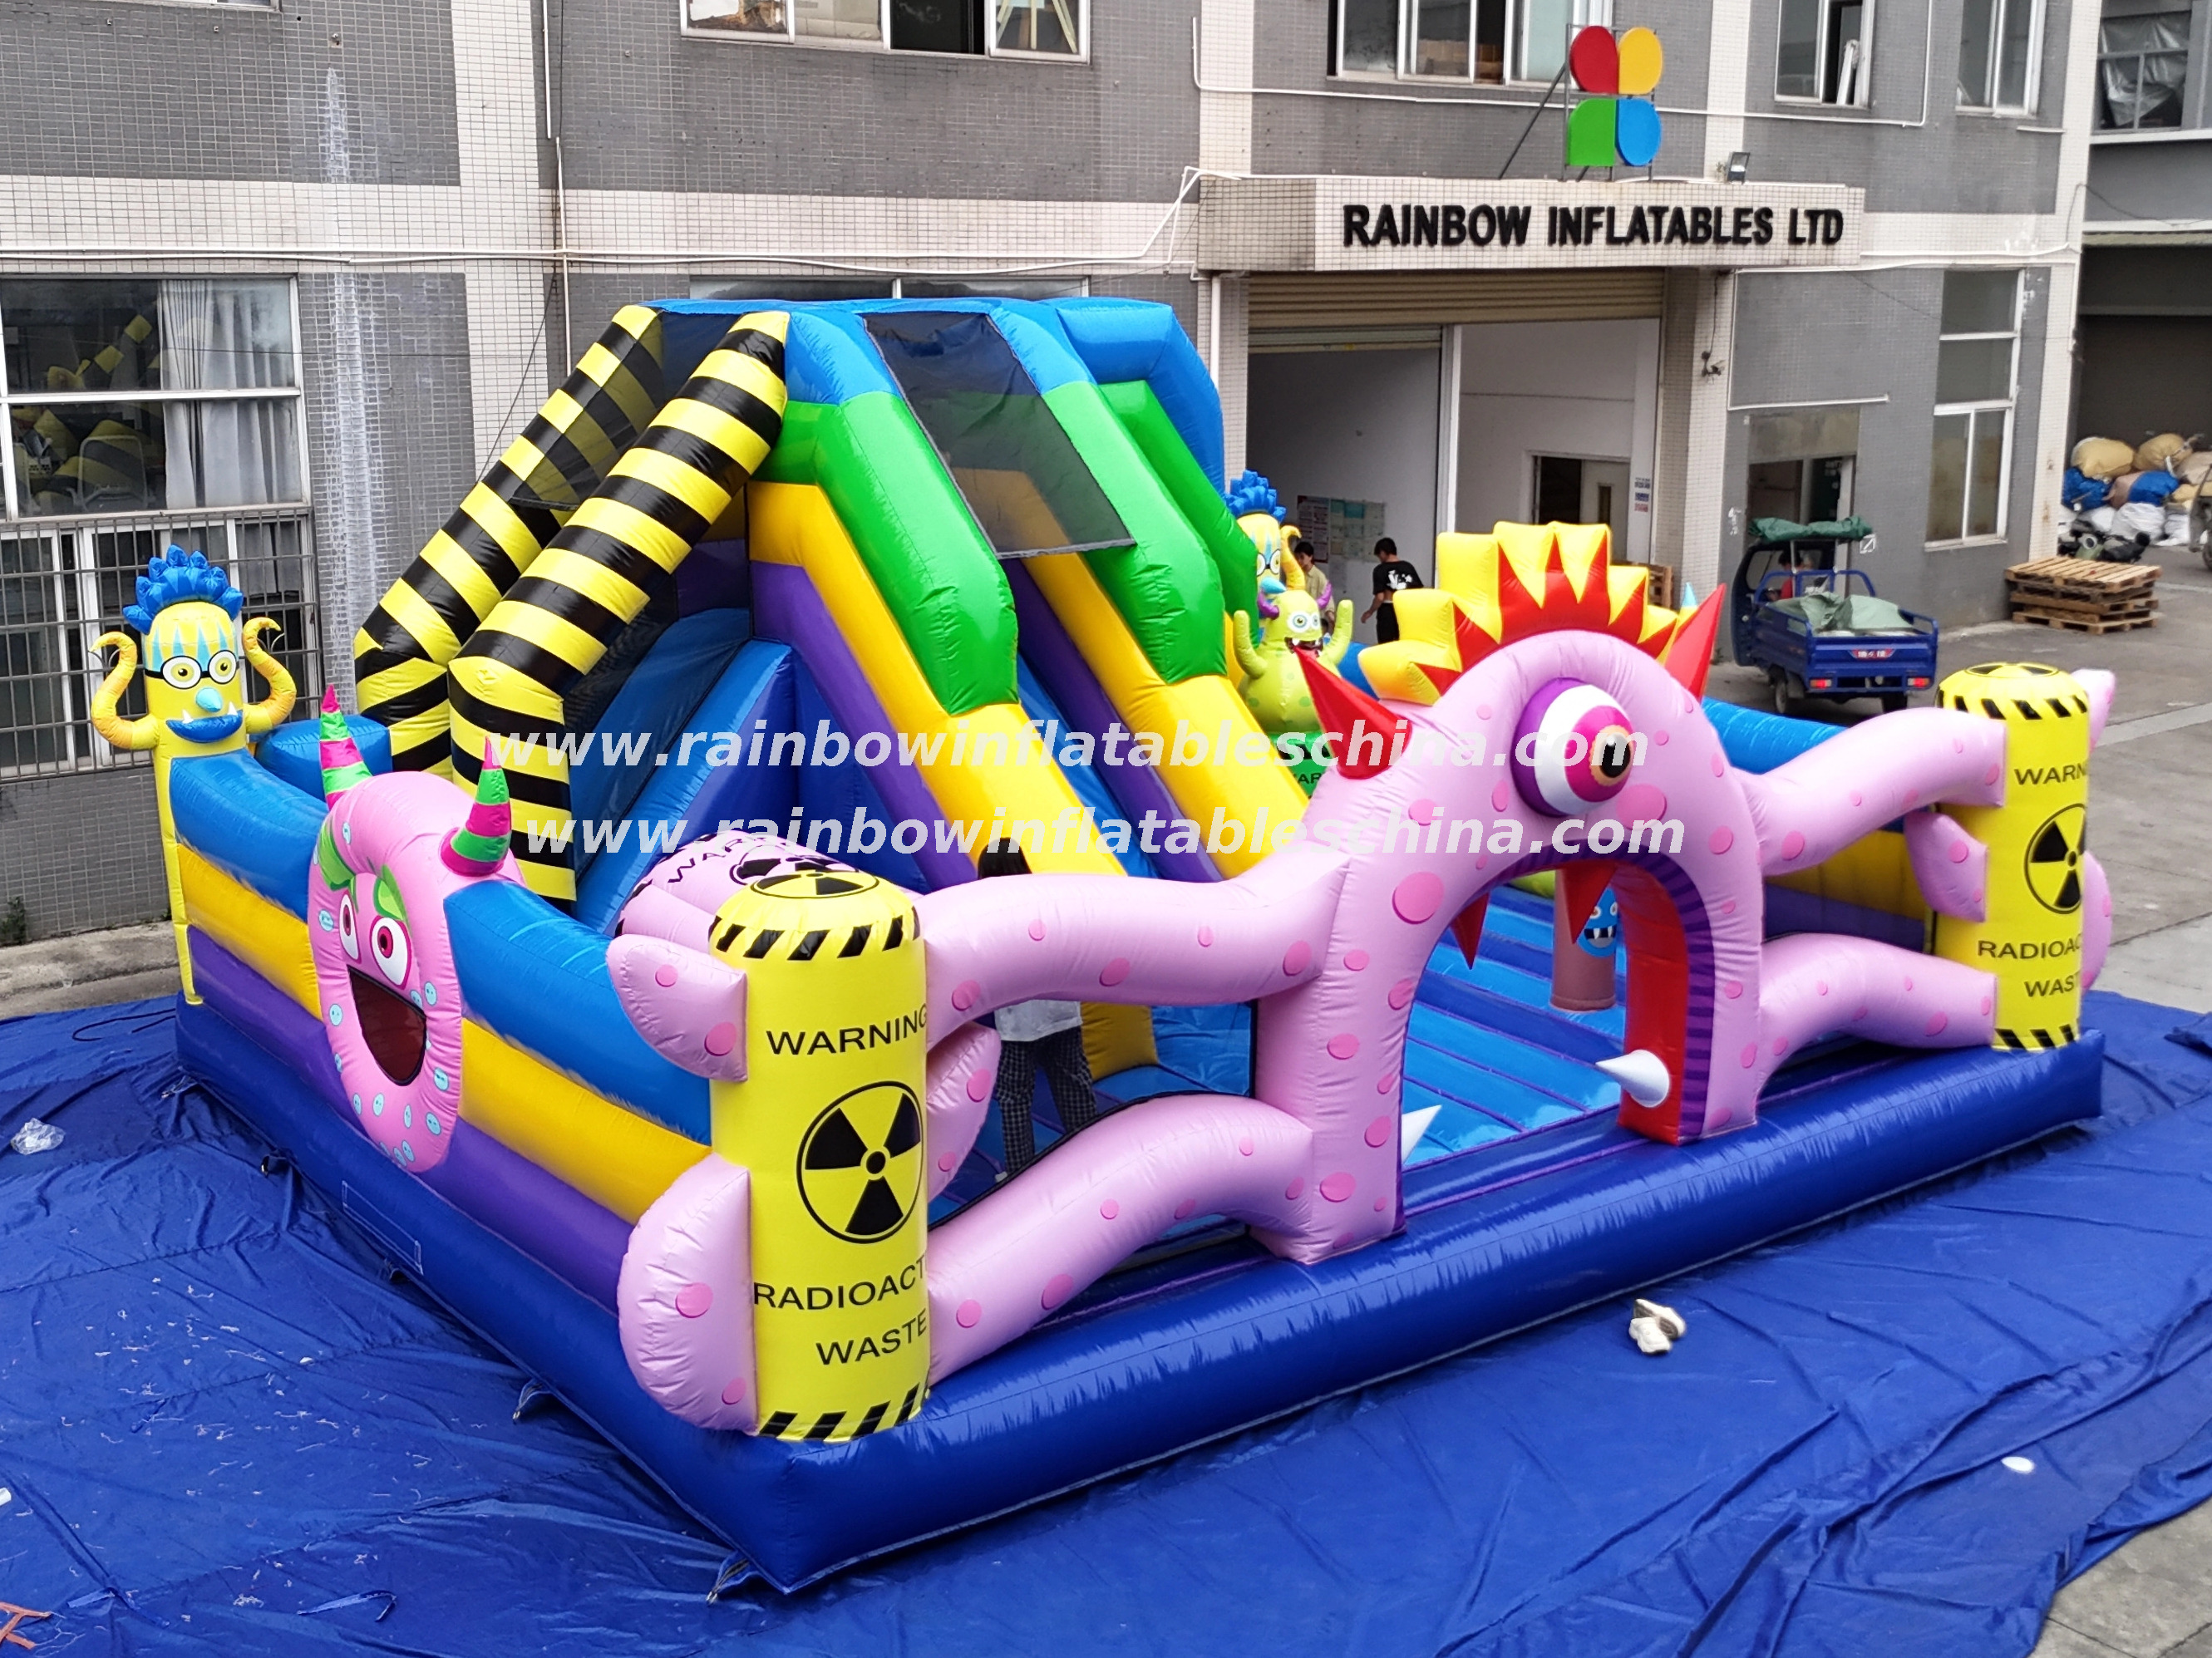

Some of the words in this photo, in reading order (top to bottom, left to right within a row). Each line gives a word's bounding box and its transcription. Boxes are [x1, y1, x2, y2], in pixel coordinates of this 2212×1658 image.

[1342, 204, 1531, 247] RAINBOW
[1547, 205, 1773, 246] INFLATABLES
[1787, 207, 1844, 245] LTD
[766, 1002, 927, 1055] WARNING
[815, 1307, 927, 1365] WASTE
